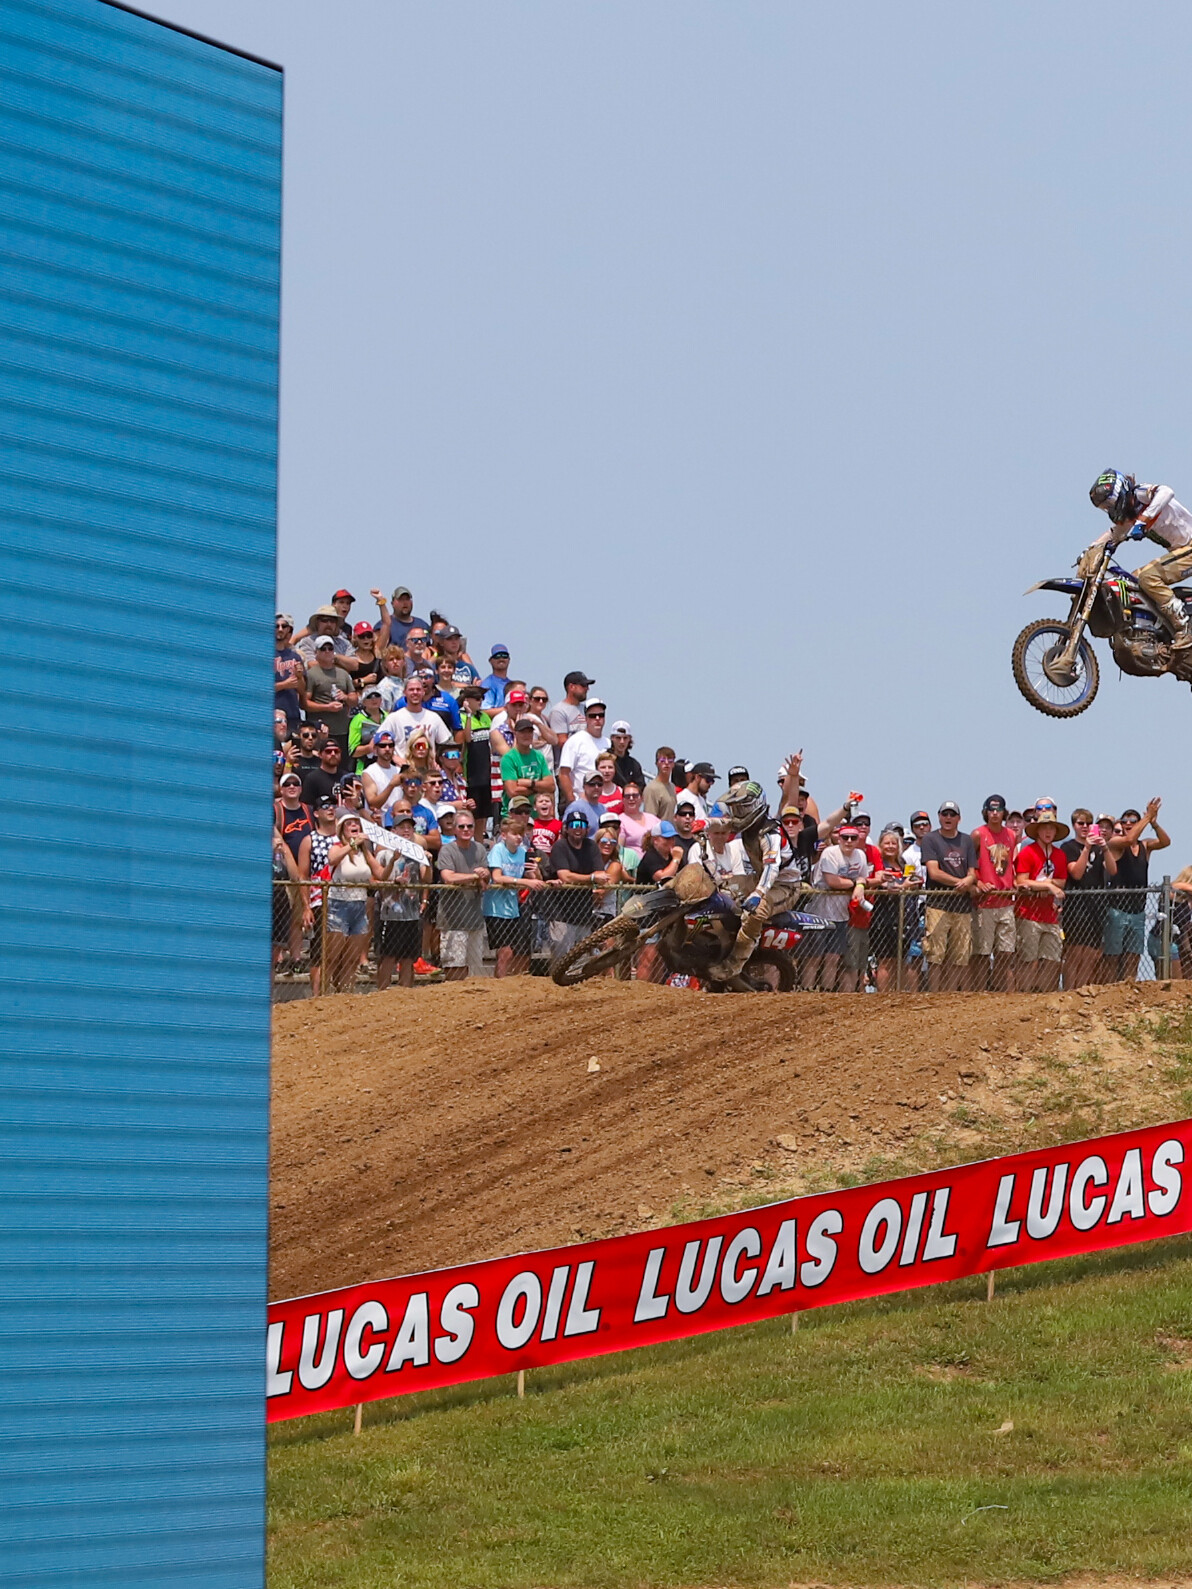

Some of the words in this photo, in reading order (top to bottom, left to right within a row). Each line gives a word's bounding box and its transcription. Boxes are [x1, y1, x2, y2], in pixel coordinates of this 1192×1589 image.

[763, 928, 789, 950] 14
[632, 1197, 844, 1323] LUCAS
[857, 1186, 959, 1274] OIL
[986, 1138, 1185, 1248] LUCAS
[266, 1282, 480, 1398] LUCAS
[495, 1259, 602, 1350] OIL
